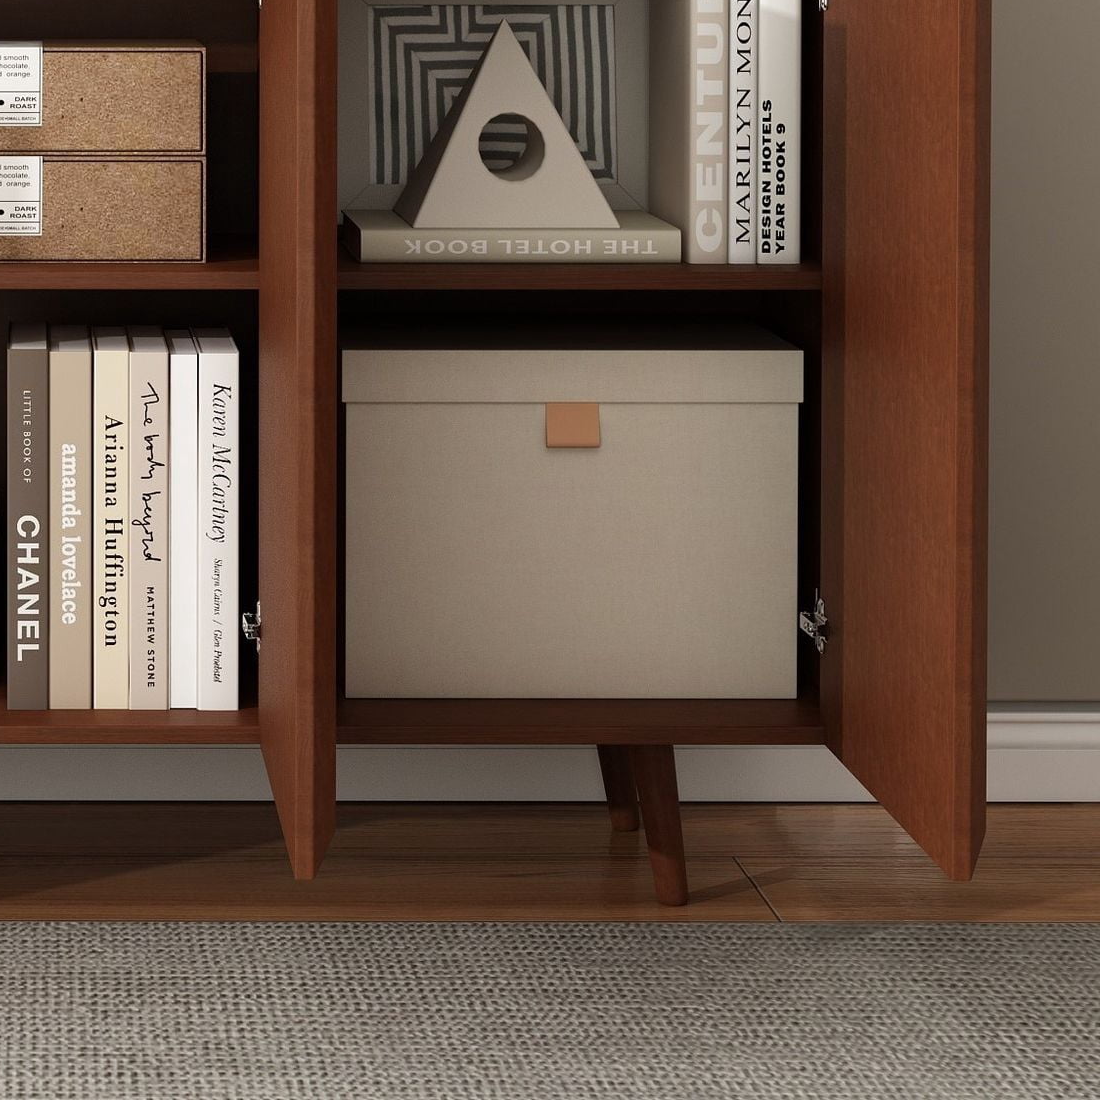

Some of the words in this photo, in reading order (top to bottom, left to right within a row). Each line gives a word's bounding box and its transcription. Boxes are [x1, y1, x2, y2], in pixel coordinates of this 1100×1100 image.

[762, 99, 772, 173] HOTELS
[776, 123, 786, 134] 9
[735, 88, 752, 245] MARILYN
[775, 142, 785, 197] BOOK
[404, 239, 488, 255] BOOK
[497, 239, 592, 255] HOTEL
[603, 239, 659, 255] THE
[762, 187, 771, 255] DESIGN
[775, 203, 785, 255] YEAR
[23, 390, 32, 426] LITTLE
[141, 381, 160, 427] The
[212, 383, 232, 437] Karen
[23, 431, 32, 465] BOOK
[104, 415, 125, 508] Arianna
[141, 434, 166, 480] body
[23, 468, 32, 484] OF
[61, 443, 82, 530] amanda
[206, 444, 232, 543] McCartney
[131, 491, 162, 562] beyond
[16, 514, 41, 662] CHANEL
[61, 535, 82, 625] lovelace
[99, 518, 125, 647] Huffington
[146, 586, 155, 645] MATTHEW
[146, 650, 155, 688] STONE
